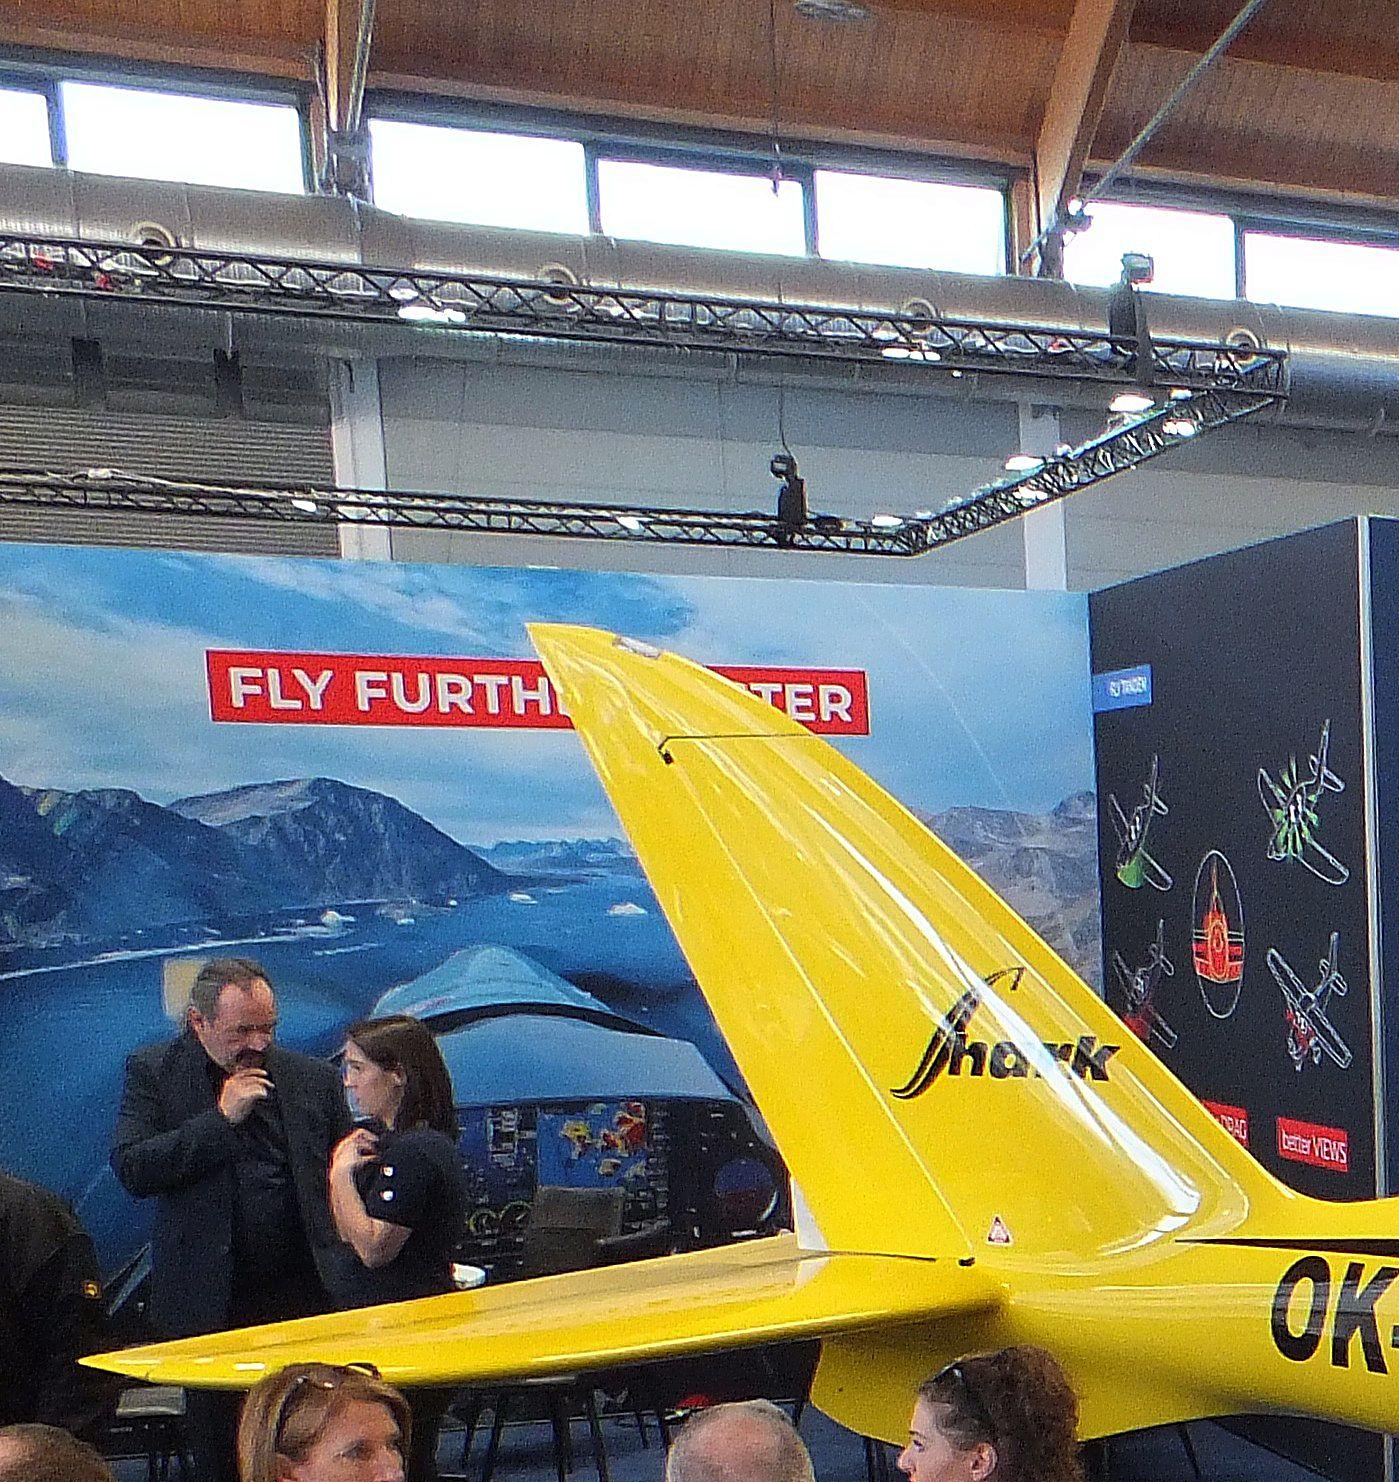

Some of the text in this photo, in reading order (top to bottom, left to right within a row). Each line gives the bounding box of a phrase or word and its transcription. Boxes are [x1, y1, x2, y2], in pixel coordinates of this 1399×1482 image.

[228, 666, 852, 722] FLY FURTH TER
[1312, 1135, 1347, 1164] VIEWS
